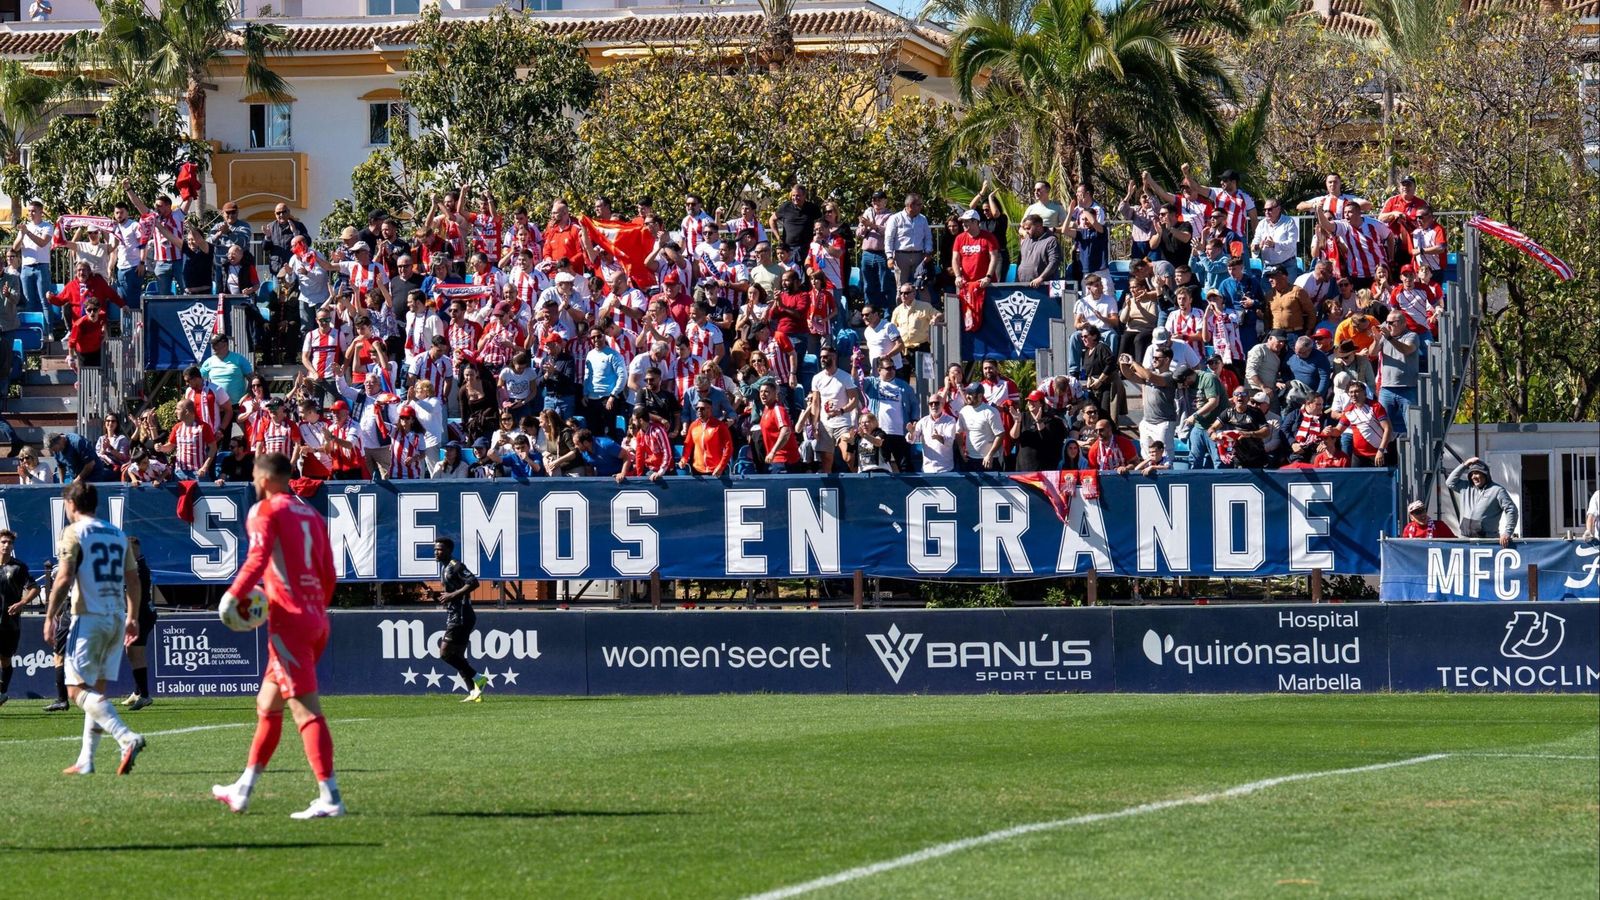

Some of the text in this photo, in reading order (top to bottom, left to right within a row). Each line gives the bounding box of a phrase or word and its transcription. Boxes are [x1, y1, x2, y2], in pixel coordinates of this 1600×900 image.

[190, 485, 661, 580] SÑEMOS
[724, 486, 841, 576] EN
[906, 482, 1335, 575] GRANDE
[300, 520, 313, 570] 1
[90, 542, 124, 583] 22
[1427, 547, 1521, 601] MFC
[163, 625, 186, 635] sabor
[1278, 610, 1359, 631] Hospital
[601, 642, 832, 669] women'secret
[926, 633, 1092, 668] BANÚS
[1174, 636, 1360, 674] quirónsalud
[157, 680, 259, 695] El sabor que nos une
[975, 670, 1092, 682] SPORT CLUB
[1278, 673, 1361, 691] Marbella
